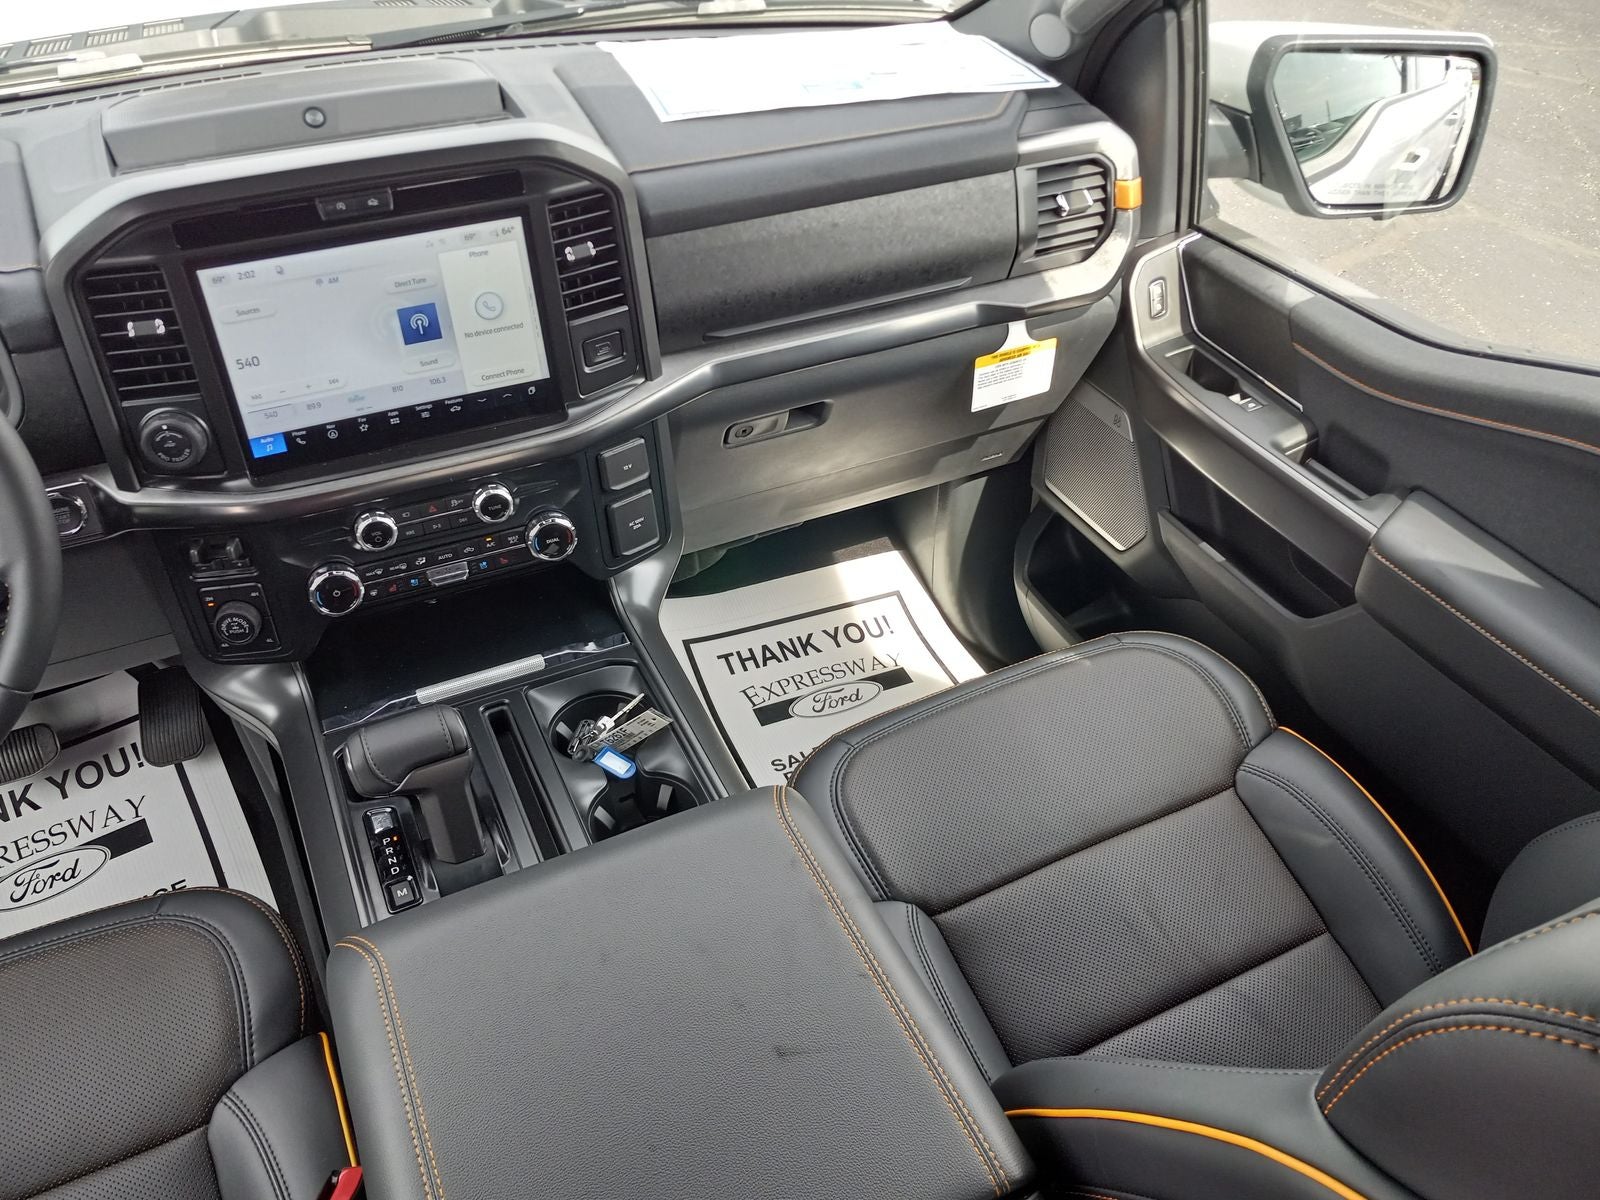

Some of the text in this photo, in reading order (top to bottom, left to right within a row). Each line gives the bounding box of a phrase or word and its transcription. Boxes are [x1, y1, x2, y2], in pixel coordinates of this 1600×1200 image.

[469, 249, 489, 259] Phone
[237, 270, 256, 281] 2:02
[328, 276, 339, 284] AM
[394, 277, 427, 289] Direct Tune
[236, 307, 261, 317] Sources
[464, 322, 524, 339] No device connected
[236, 356, 260, 370] 540
[420, 358, 439, 367] Sound
[481, 367, 526, 382] Connect Phone
[264, 411, 278, 420] 540
[717, 615, 894, 675] THANK YOU!
[740, 653, 900, 708] EXPRESSWAY
[811, 687, 863, 713] Ford
[44, 742, 144, 800] YOU!
[383, 837, 391, 845] P
[385, 847, 394, 855] R
[388, 856, 397, 865] N
[390, 866, 400, 875] D
[10, 858, 82, 903] Ford
[396, 888, 408, 897] M
